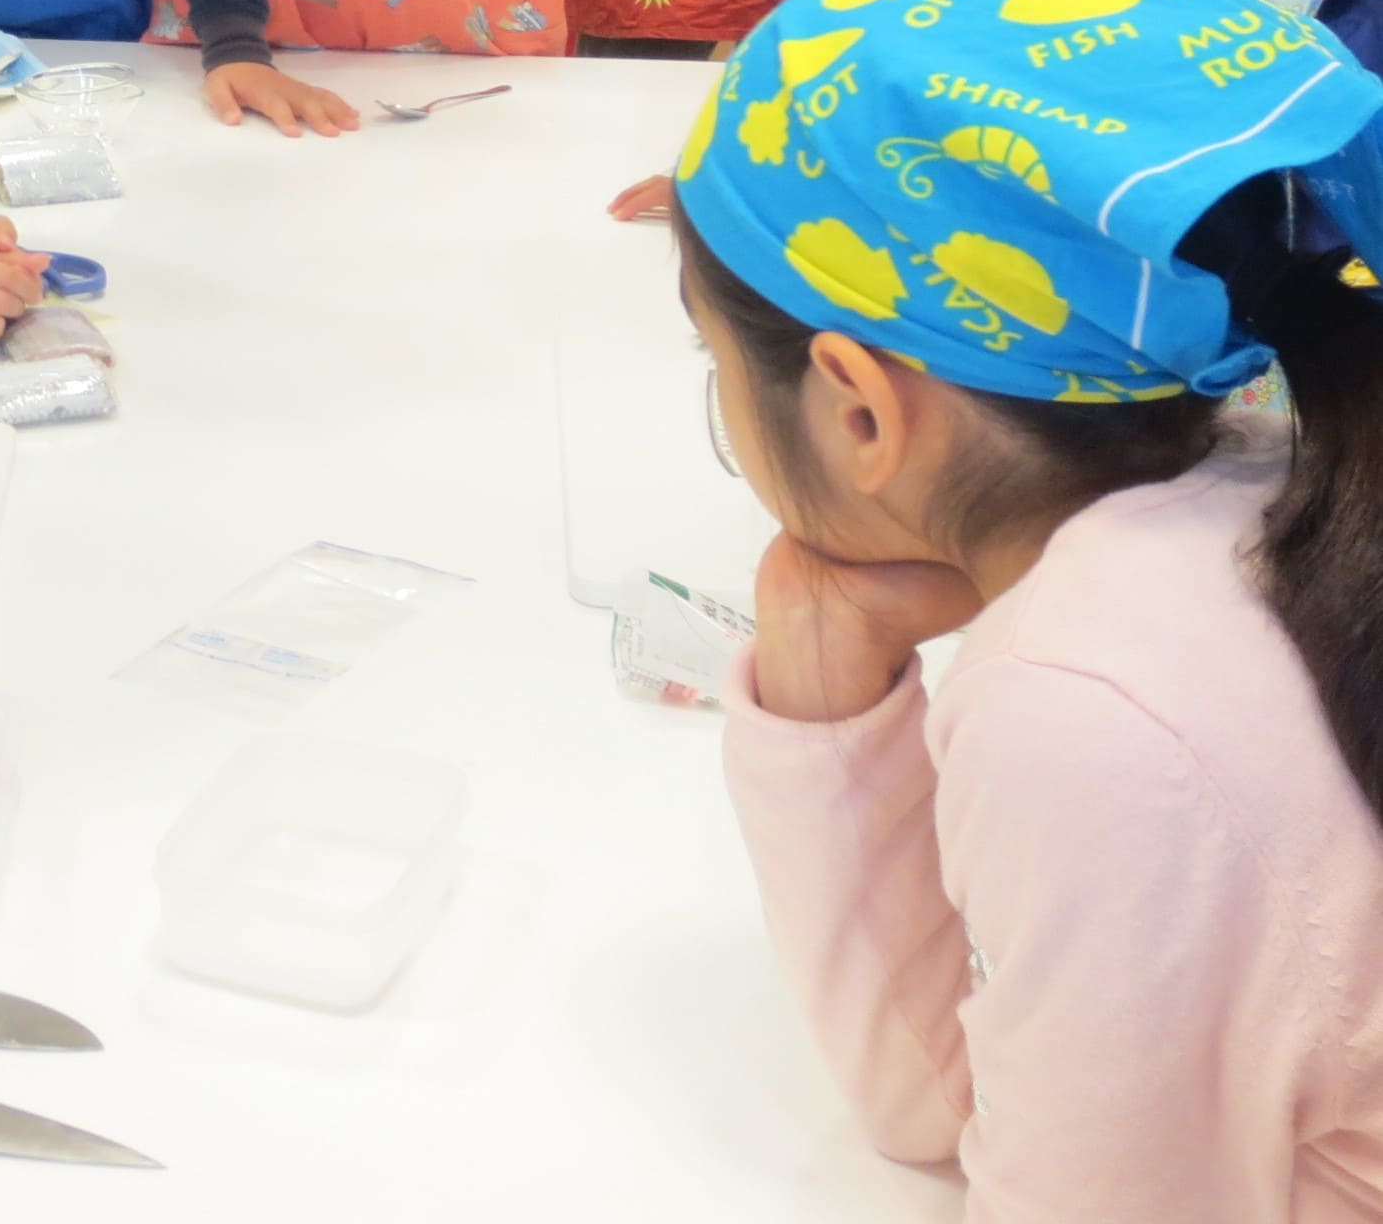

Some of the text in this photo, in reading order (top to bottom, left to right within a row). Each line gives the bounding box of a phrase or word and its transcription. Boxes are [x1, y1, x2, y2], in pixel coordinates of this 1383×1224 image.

[1026, 21, 1140, 69] FISH
[1178, 9, 1263, 59] MU
[923, 73, 1128, 135] SHRIMP
